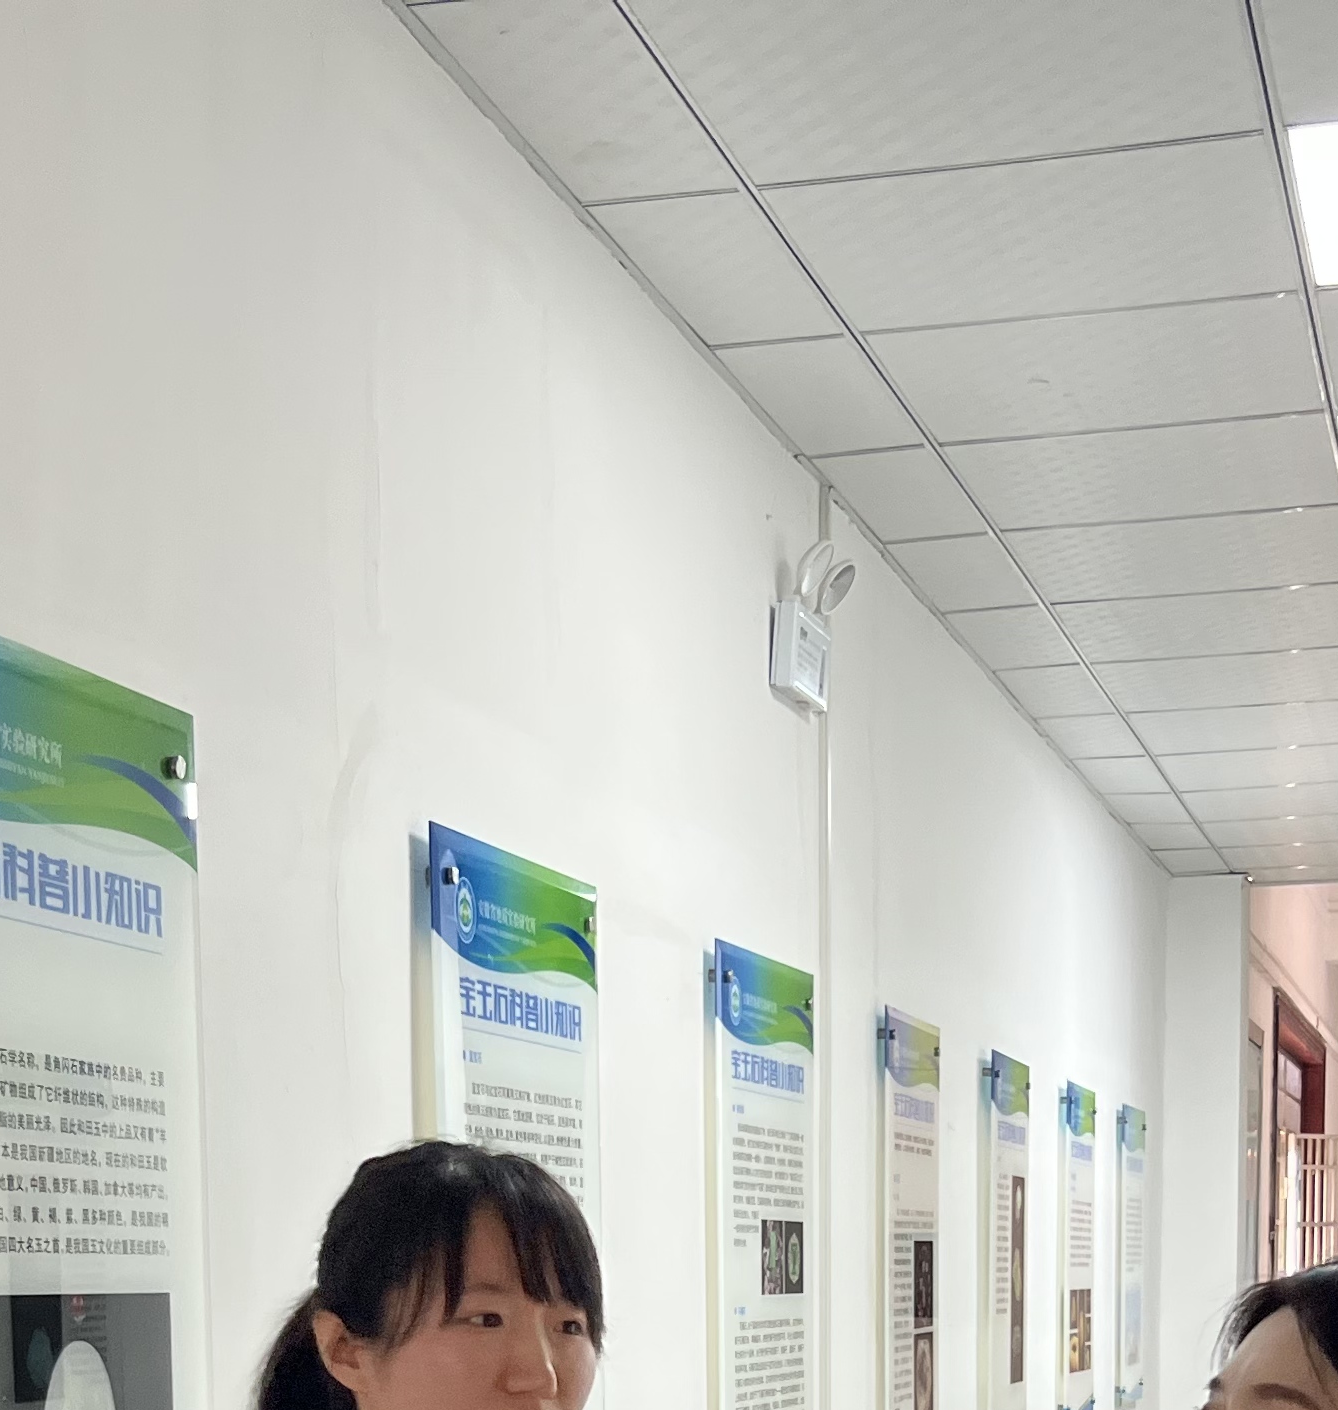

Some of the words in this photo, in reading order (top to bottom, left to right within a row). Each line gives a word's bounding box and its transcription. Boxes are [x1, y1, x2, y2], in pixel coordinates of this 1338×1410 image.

[460, 976, 582, 1042] 宝玉石科普小知识
